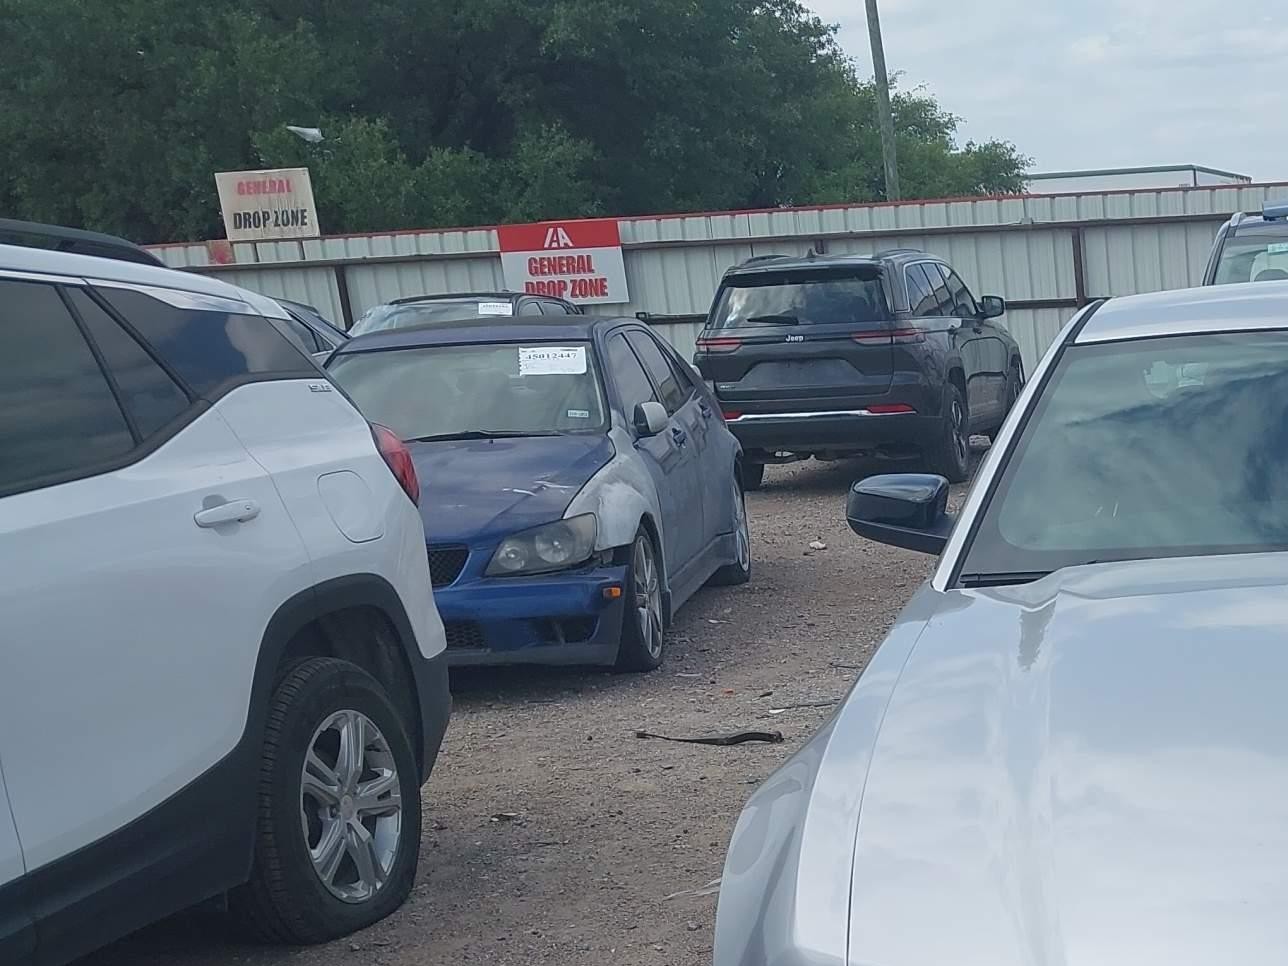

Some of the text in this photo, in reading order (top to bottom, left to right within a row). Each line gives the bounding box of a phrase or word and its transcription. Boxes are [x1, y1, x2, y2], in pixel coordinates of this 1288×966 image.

[237, 178, 292, 195] GENERAL
[233, 208, 308, 230] DROP ZONE
[527, 254, 595, 277] GENERAL
[525, 278, 609, 299] DROP ZONE
[785, 334, 804, 342] Jeep
